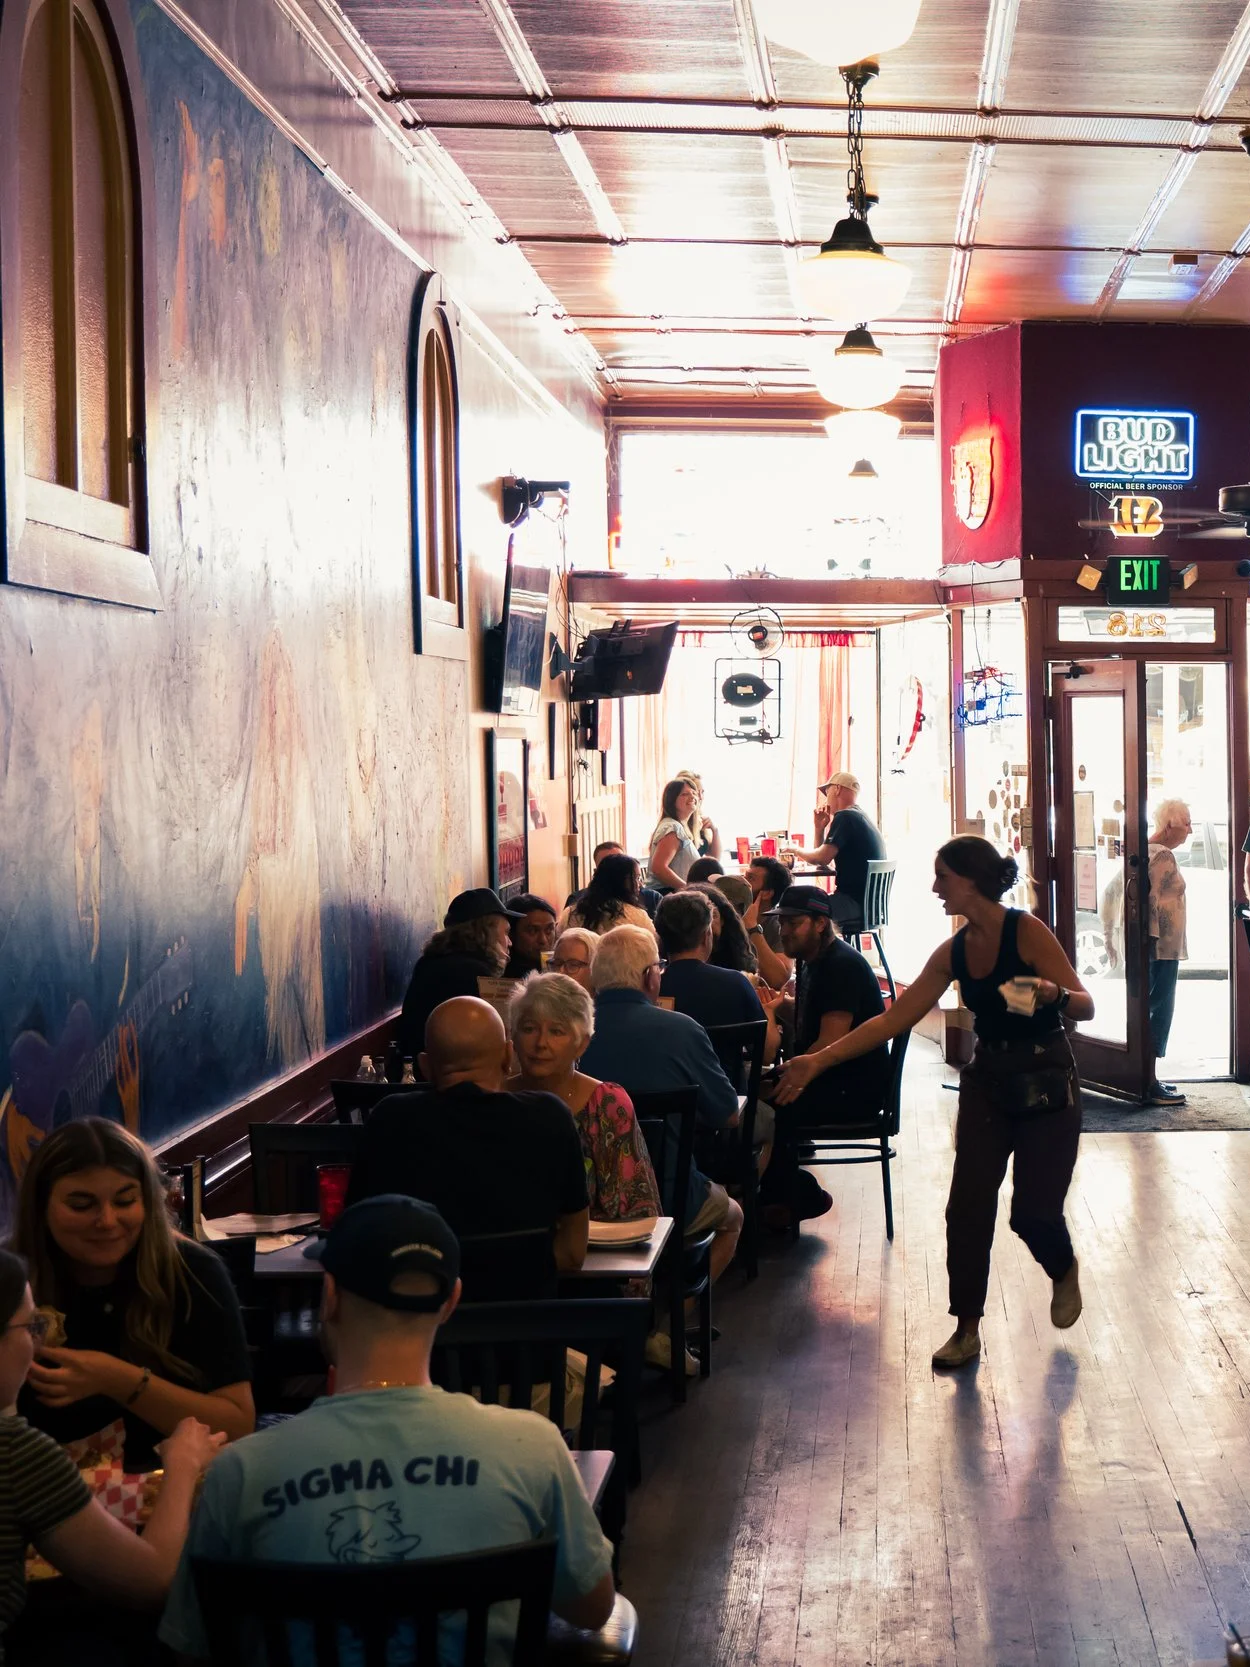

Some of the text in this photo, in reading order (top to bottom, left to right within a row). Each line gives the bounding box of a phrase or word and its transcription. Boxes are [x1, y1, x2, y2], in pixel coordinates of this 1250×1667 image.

[1098, 416, 1176, 446] BUD
[1083, 443, 1189, 472] LIGHT
[1089, 482, 1124, 490] OFFICIAL
[1147, 483, 1184, 491] SPONSOR
[1120, 560, 1160, 591] EXIT
[262, 1454, 480, 1519] SIGMA CHI
